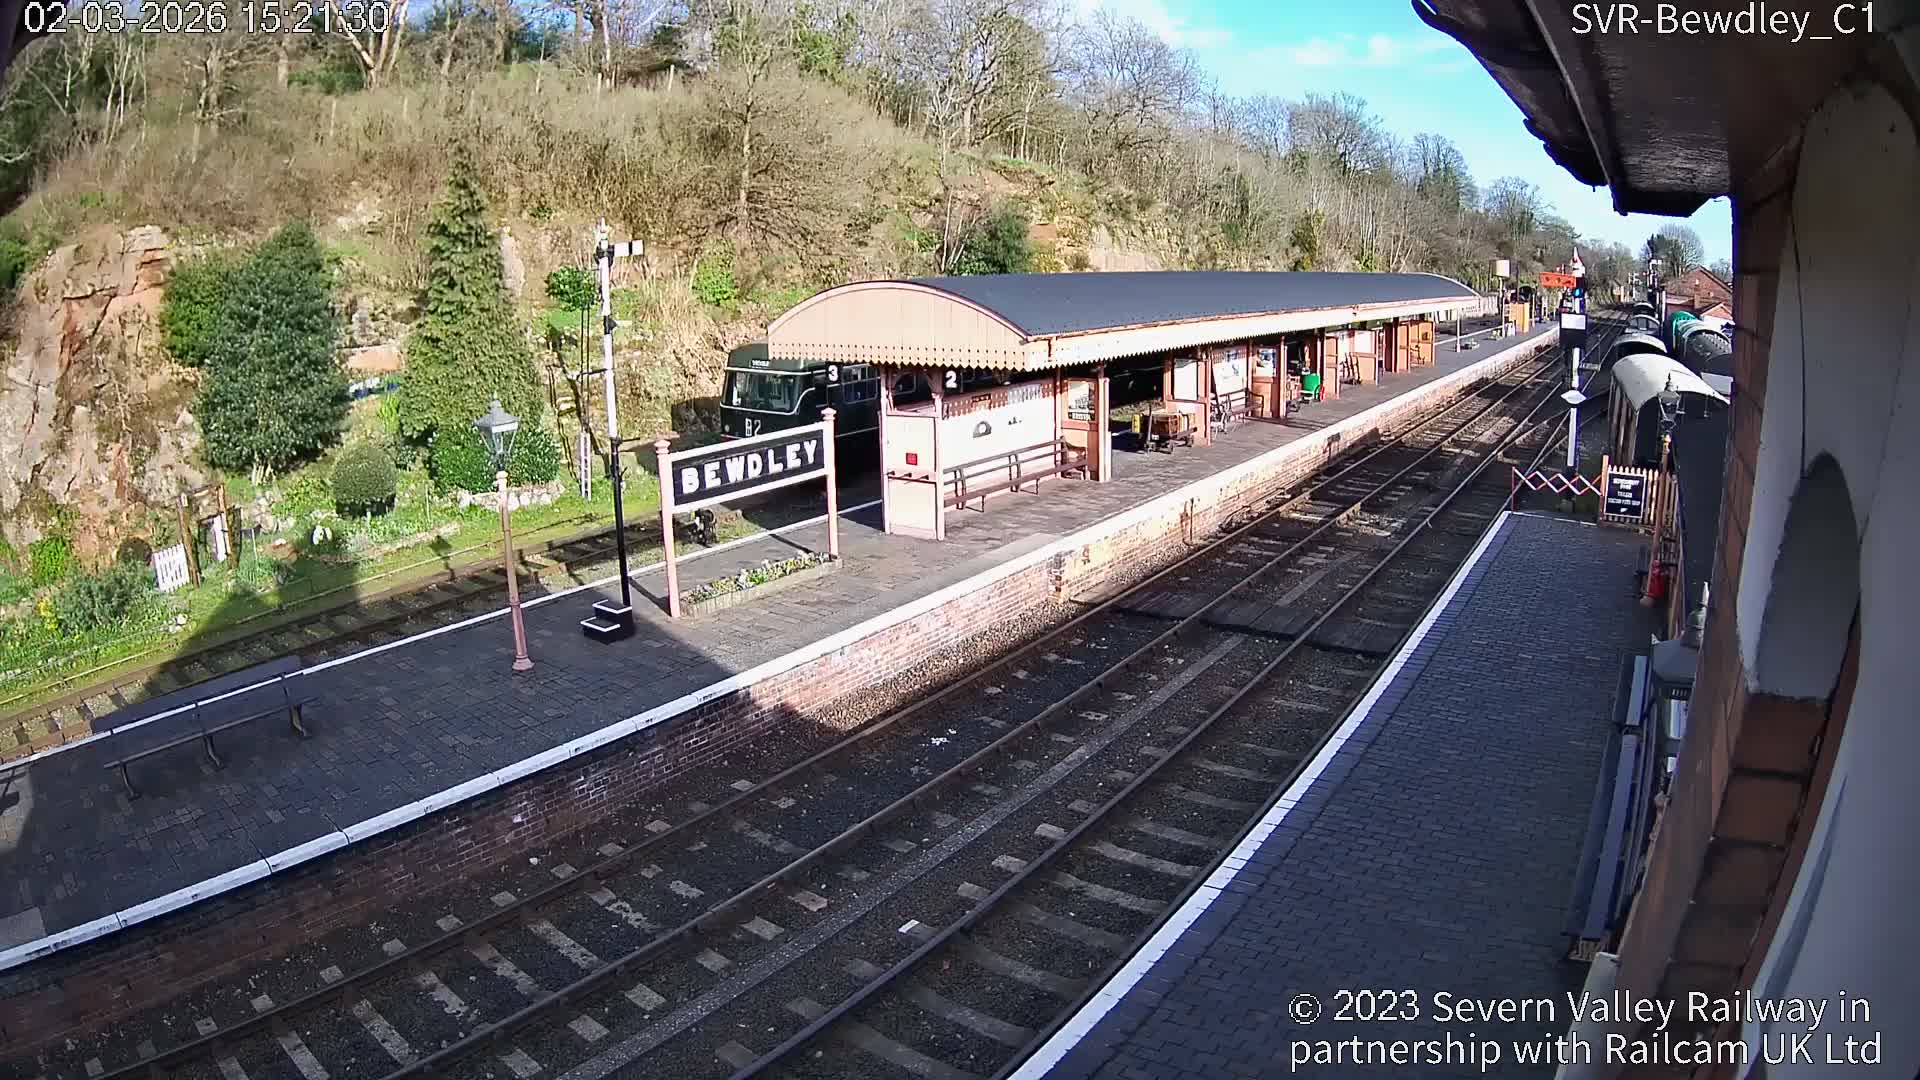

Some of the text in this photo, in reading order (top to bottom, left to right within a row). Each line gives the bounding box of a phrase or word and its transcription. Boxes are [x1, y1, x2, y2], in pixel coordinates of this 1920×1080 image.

[828, 365, 839, 382] 3
[945, 370, 958, 389] 2
[680, 439, 817, 495] BEWDLEY
